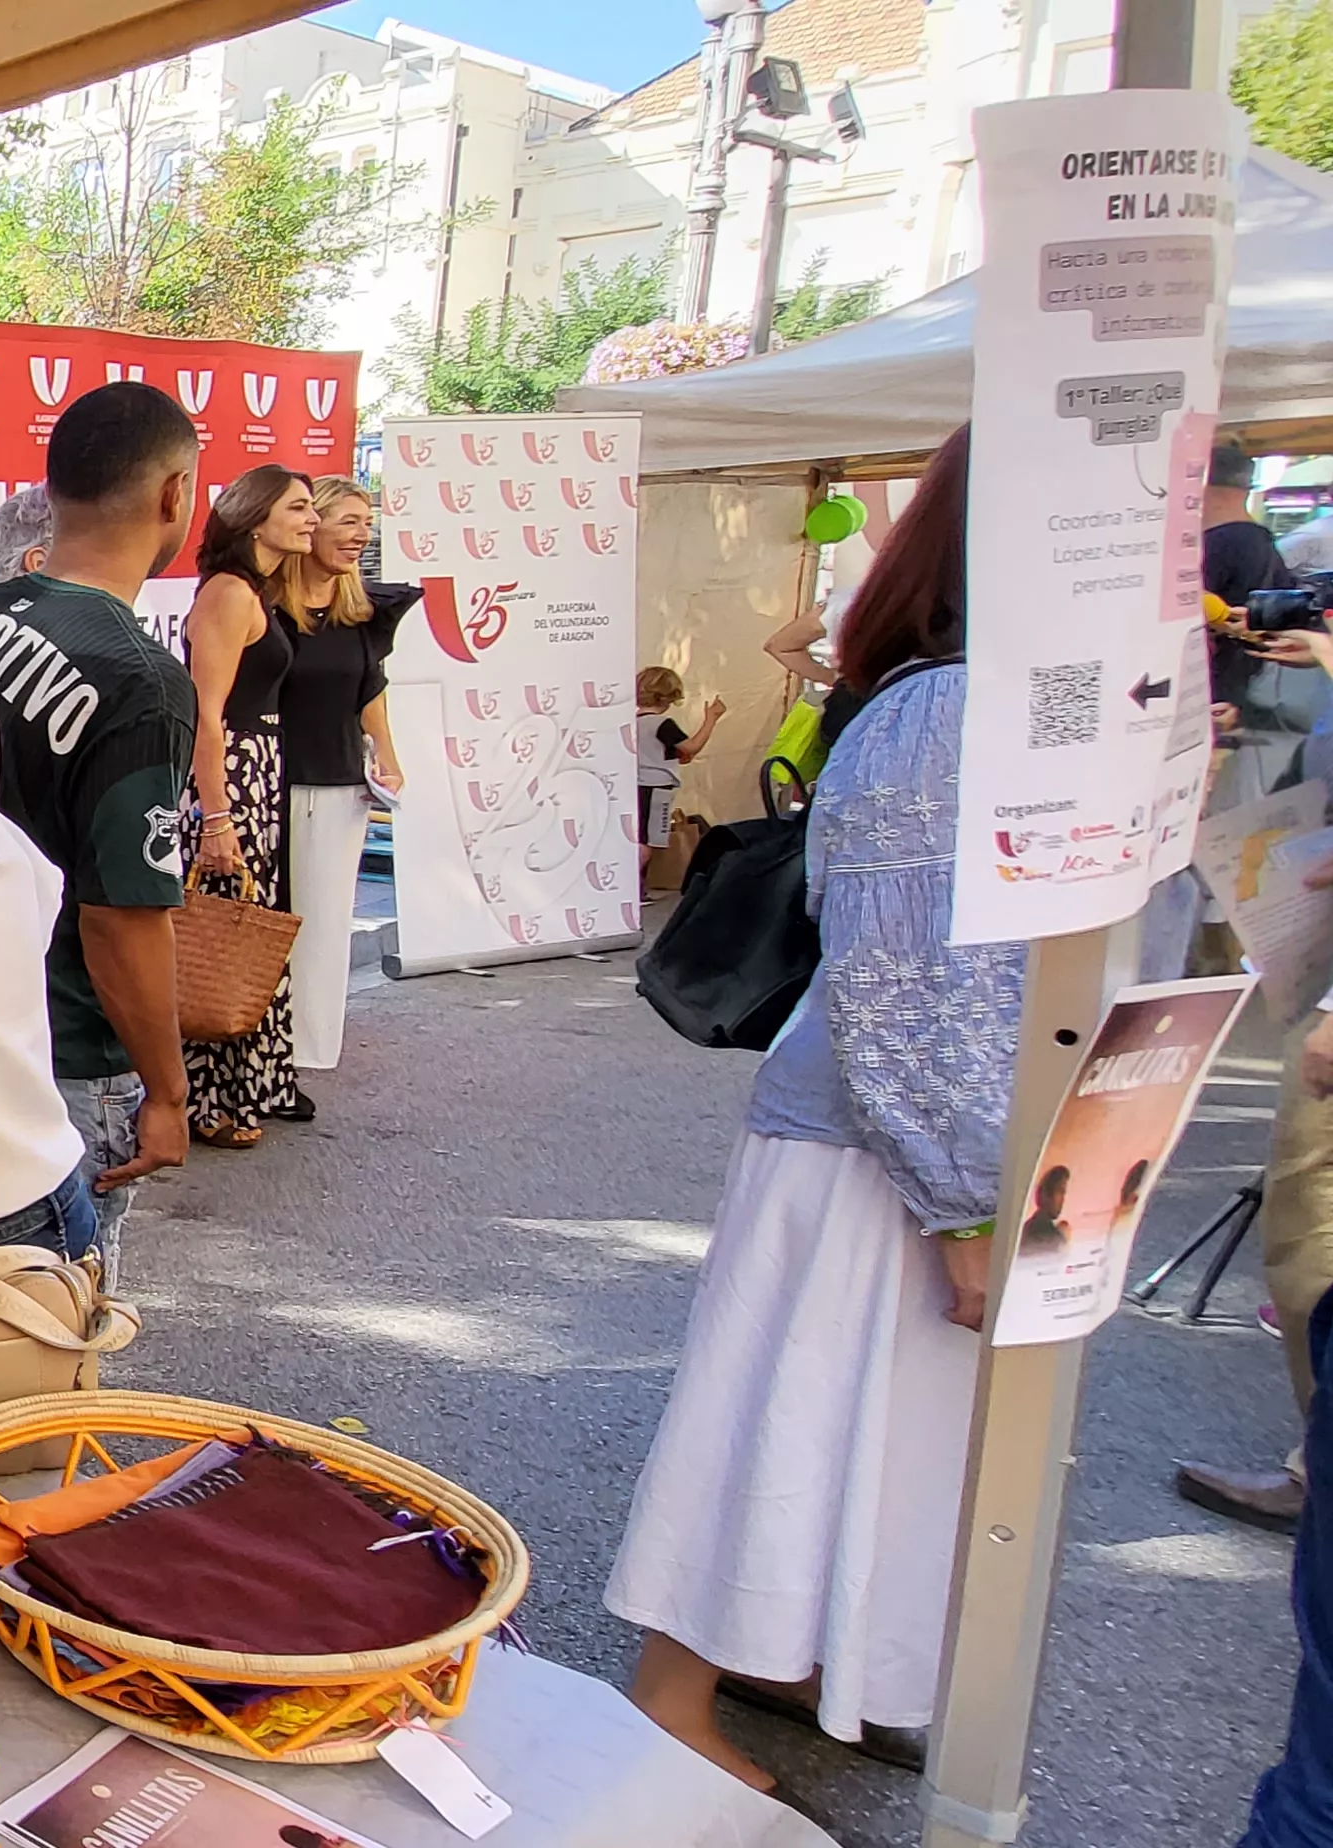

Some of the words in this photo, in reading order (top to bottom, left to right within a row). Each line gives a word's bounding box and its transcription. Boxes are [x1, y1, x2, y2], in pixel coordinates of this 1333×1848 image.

[1062, 147, 1198, 180] ORIENTARSE
[1106, 193, 1134, 221] EN
[1143, 193, 1170, 218] LA
[1047, 250, 1108, 270] Hacia
[1117, 249, 1148, 265] una
[1047, 509, 1124, 533] Coordina
[464, 581, 518, 650] 25
[547, 602, 596, 613] PLATAFORMA
[534, 619, 548, 629] DEL
[550, 616, 609, 628] VOLUNTARIADO
[549, 634, 559, 642] DE
[561, 632, 594, 641] ARAGÓN
